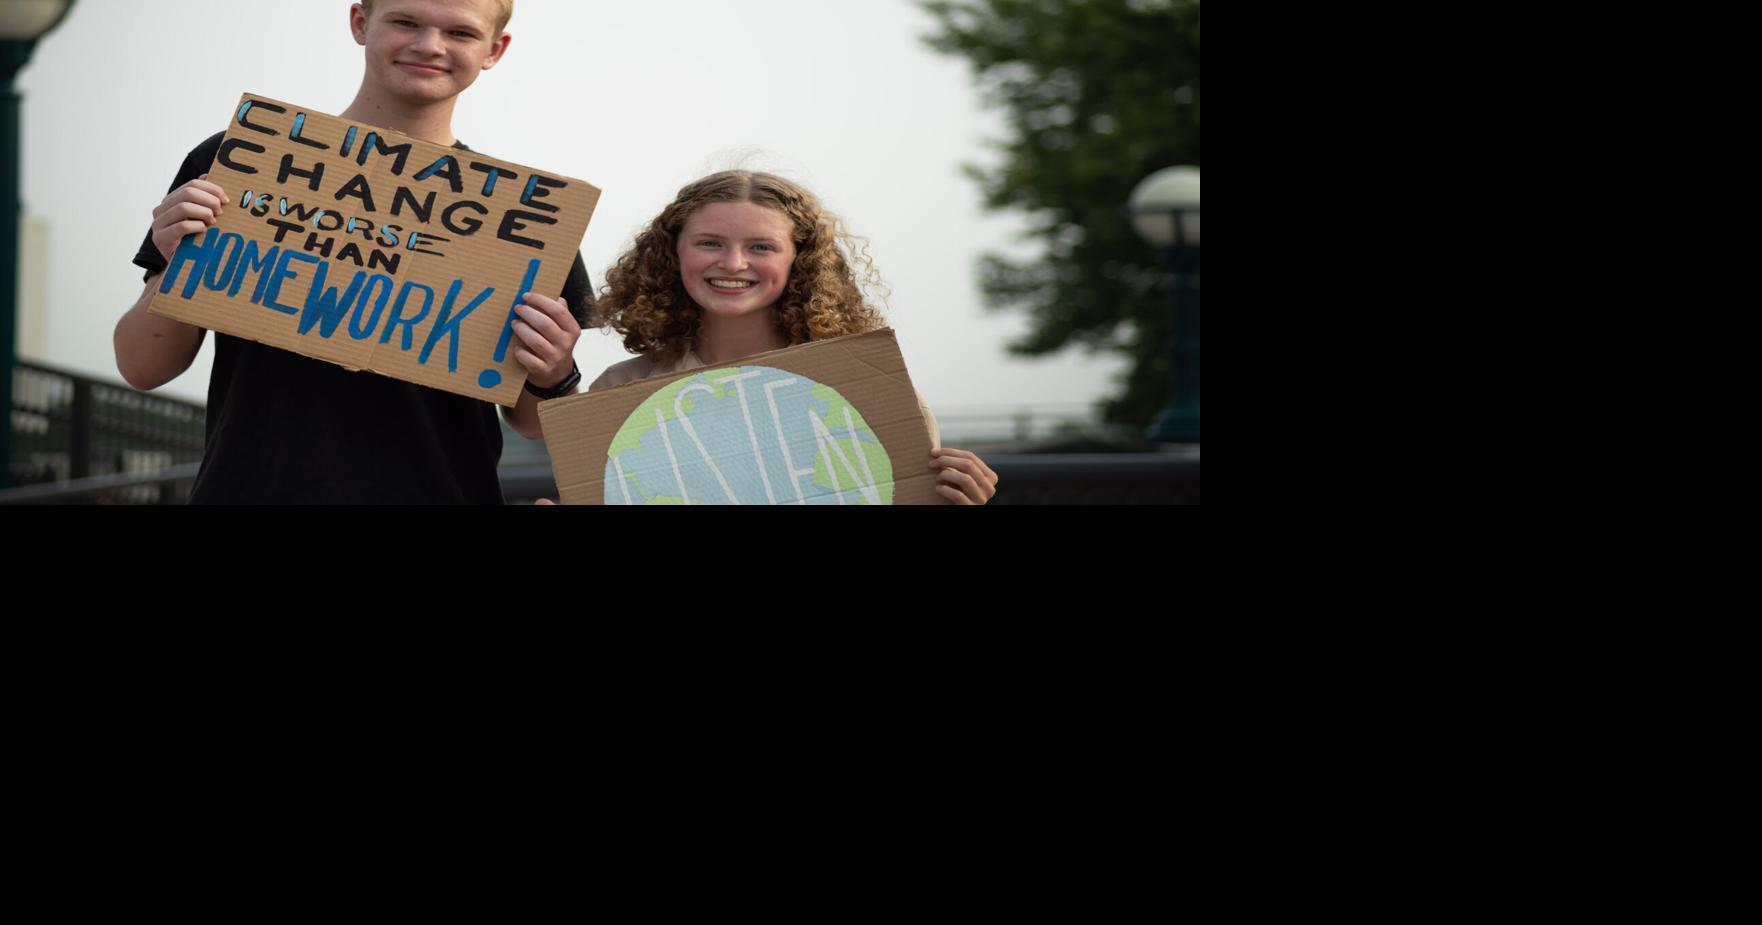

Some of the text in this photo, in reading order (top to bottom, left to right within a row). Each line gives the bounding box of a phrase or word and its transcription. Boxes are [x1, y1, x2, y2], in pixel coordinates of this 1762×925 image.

[217, 138, 558, 250] CHANGE
[236, 99, 568, 213] CLIMATE
[239, 190, 452, 256] IS WORSE
[266, 218, 401, 275] THAN
